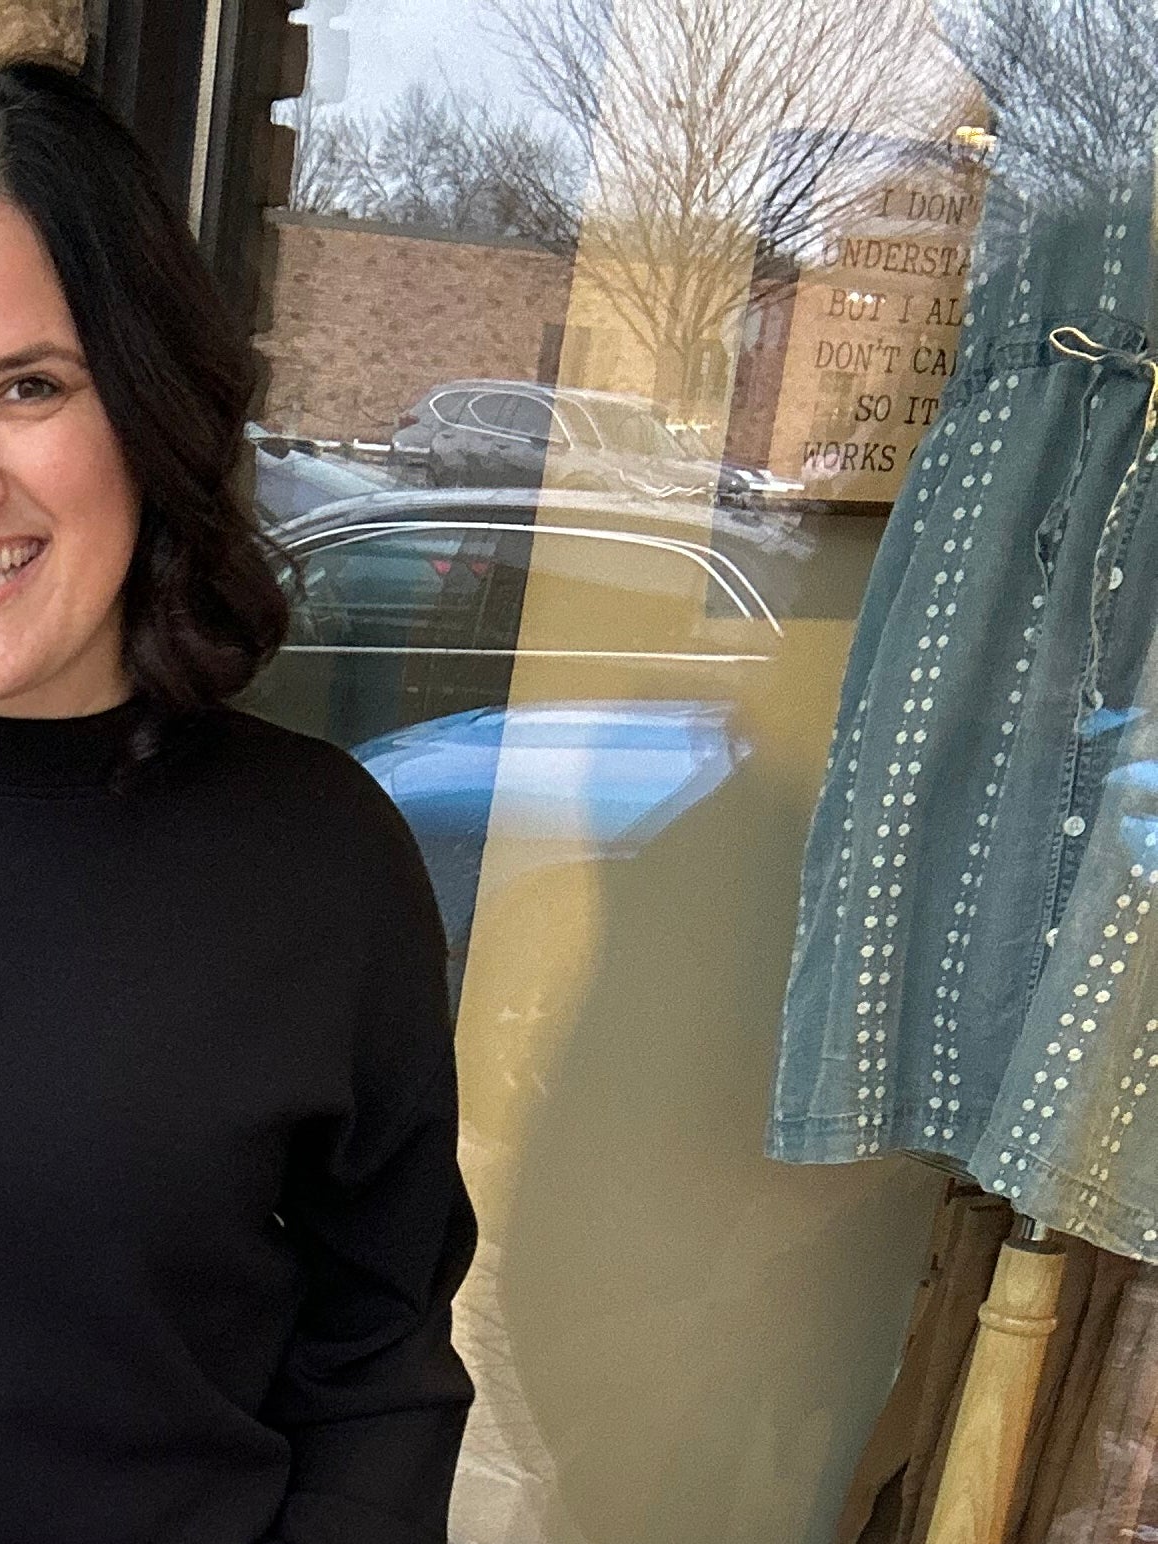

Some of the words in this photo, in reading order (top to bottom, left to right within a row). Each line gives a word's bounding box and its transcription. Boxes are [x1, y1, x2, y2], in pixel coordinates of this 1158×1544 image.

[876, 188, 894, 217] I
[907, 191, 979, 225] DON'
[828, 287, 887, 321] BUT
[898, 294, 915, 324] I
[814, 338, 901, 373] DON'T
[854, 394, 891, 422] SO
[904, 396, 939, 425] IT
[802, 441, 897, 472] WORKS
